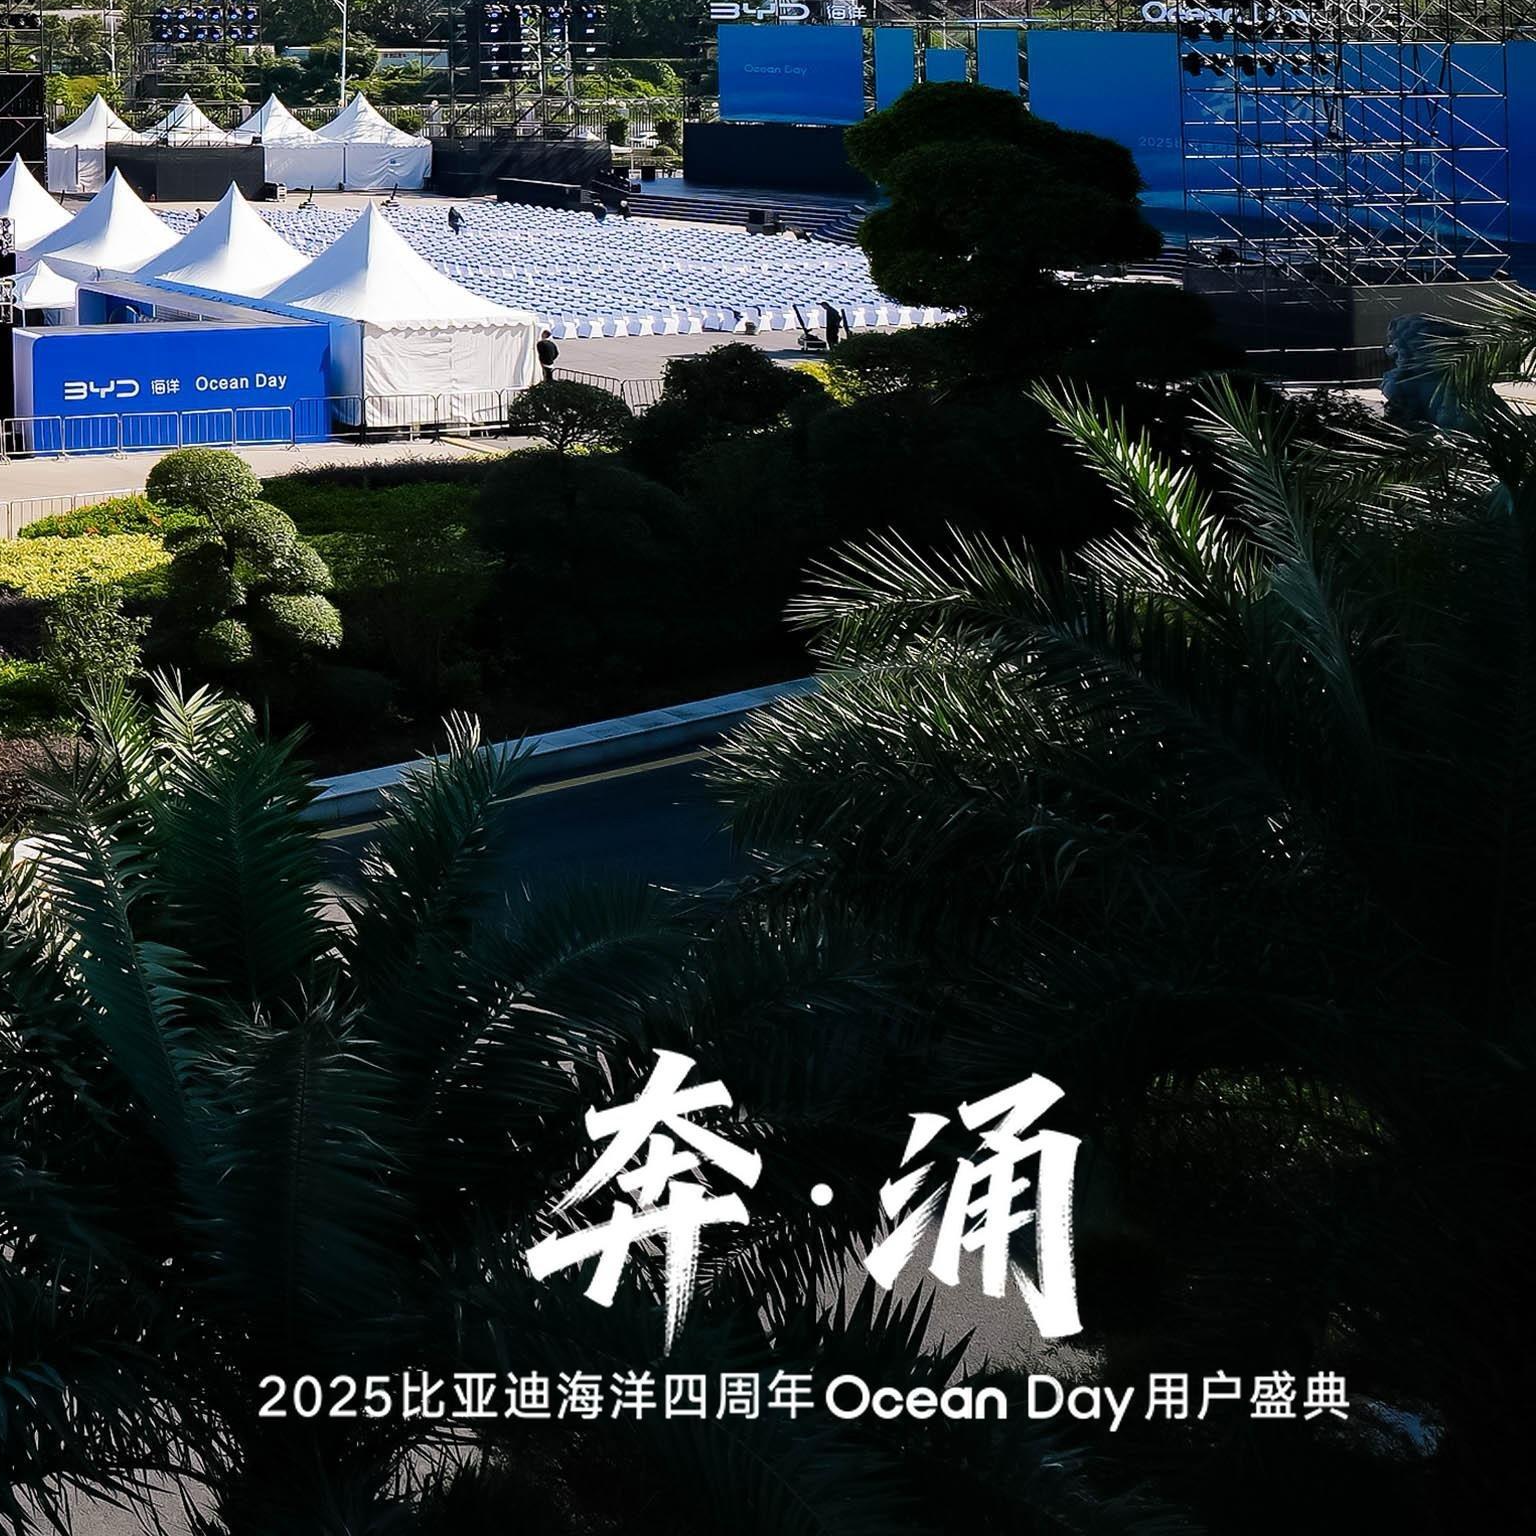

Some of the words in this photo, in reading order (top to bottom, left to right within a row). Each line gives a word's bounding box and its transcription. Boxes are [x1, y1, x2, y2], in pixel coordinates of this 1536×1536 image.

[709, 2, 810, 21] BYD
[63, 379, 140, 400] BYD
[150, 378, 181, 395] 海洋
[194, 373, 250, 392] Ocean
[254, 371, 288, 394] Day
